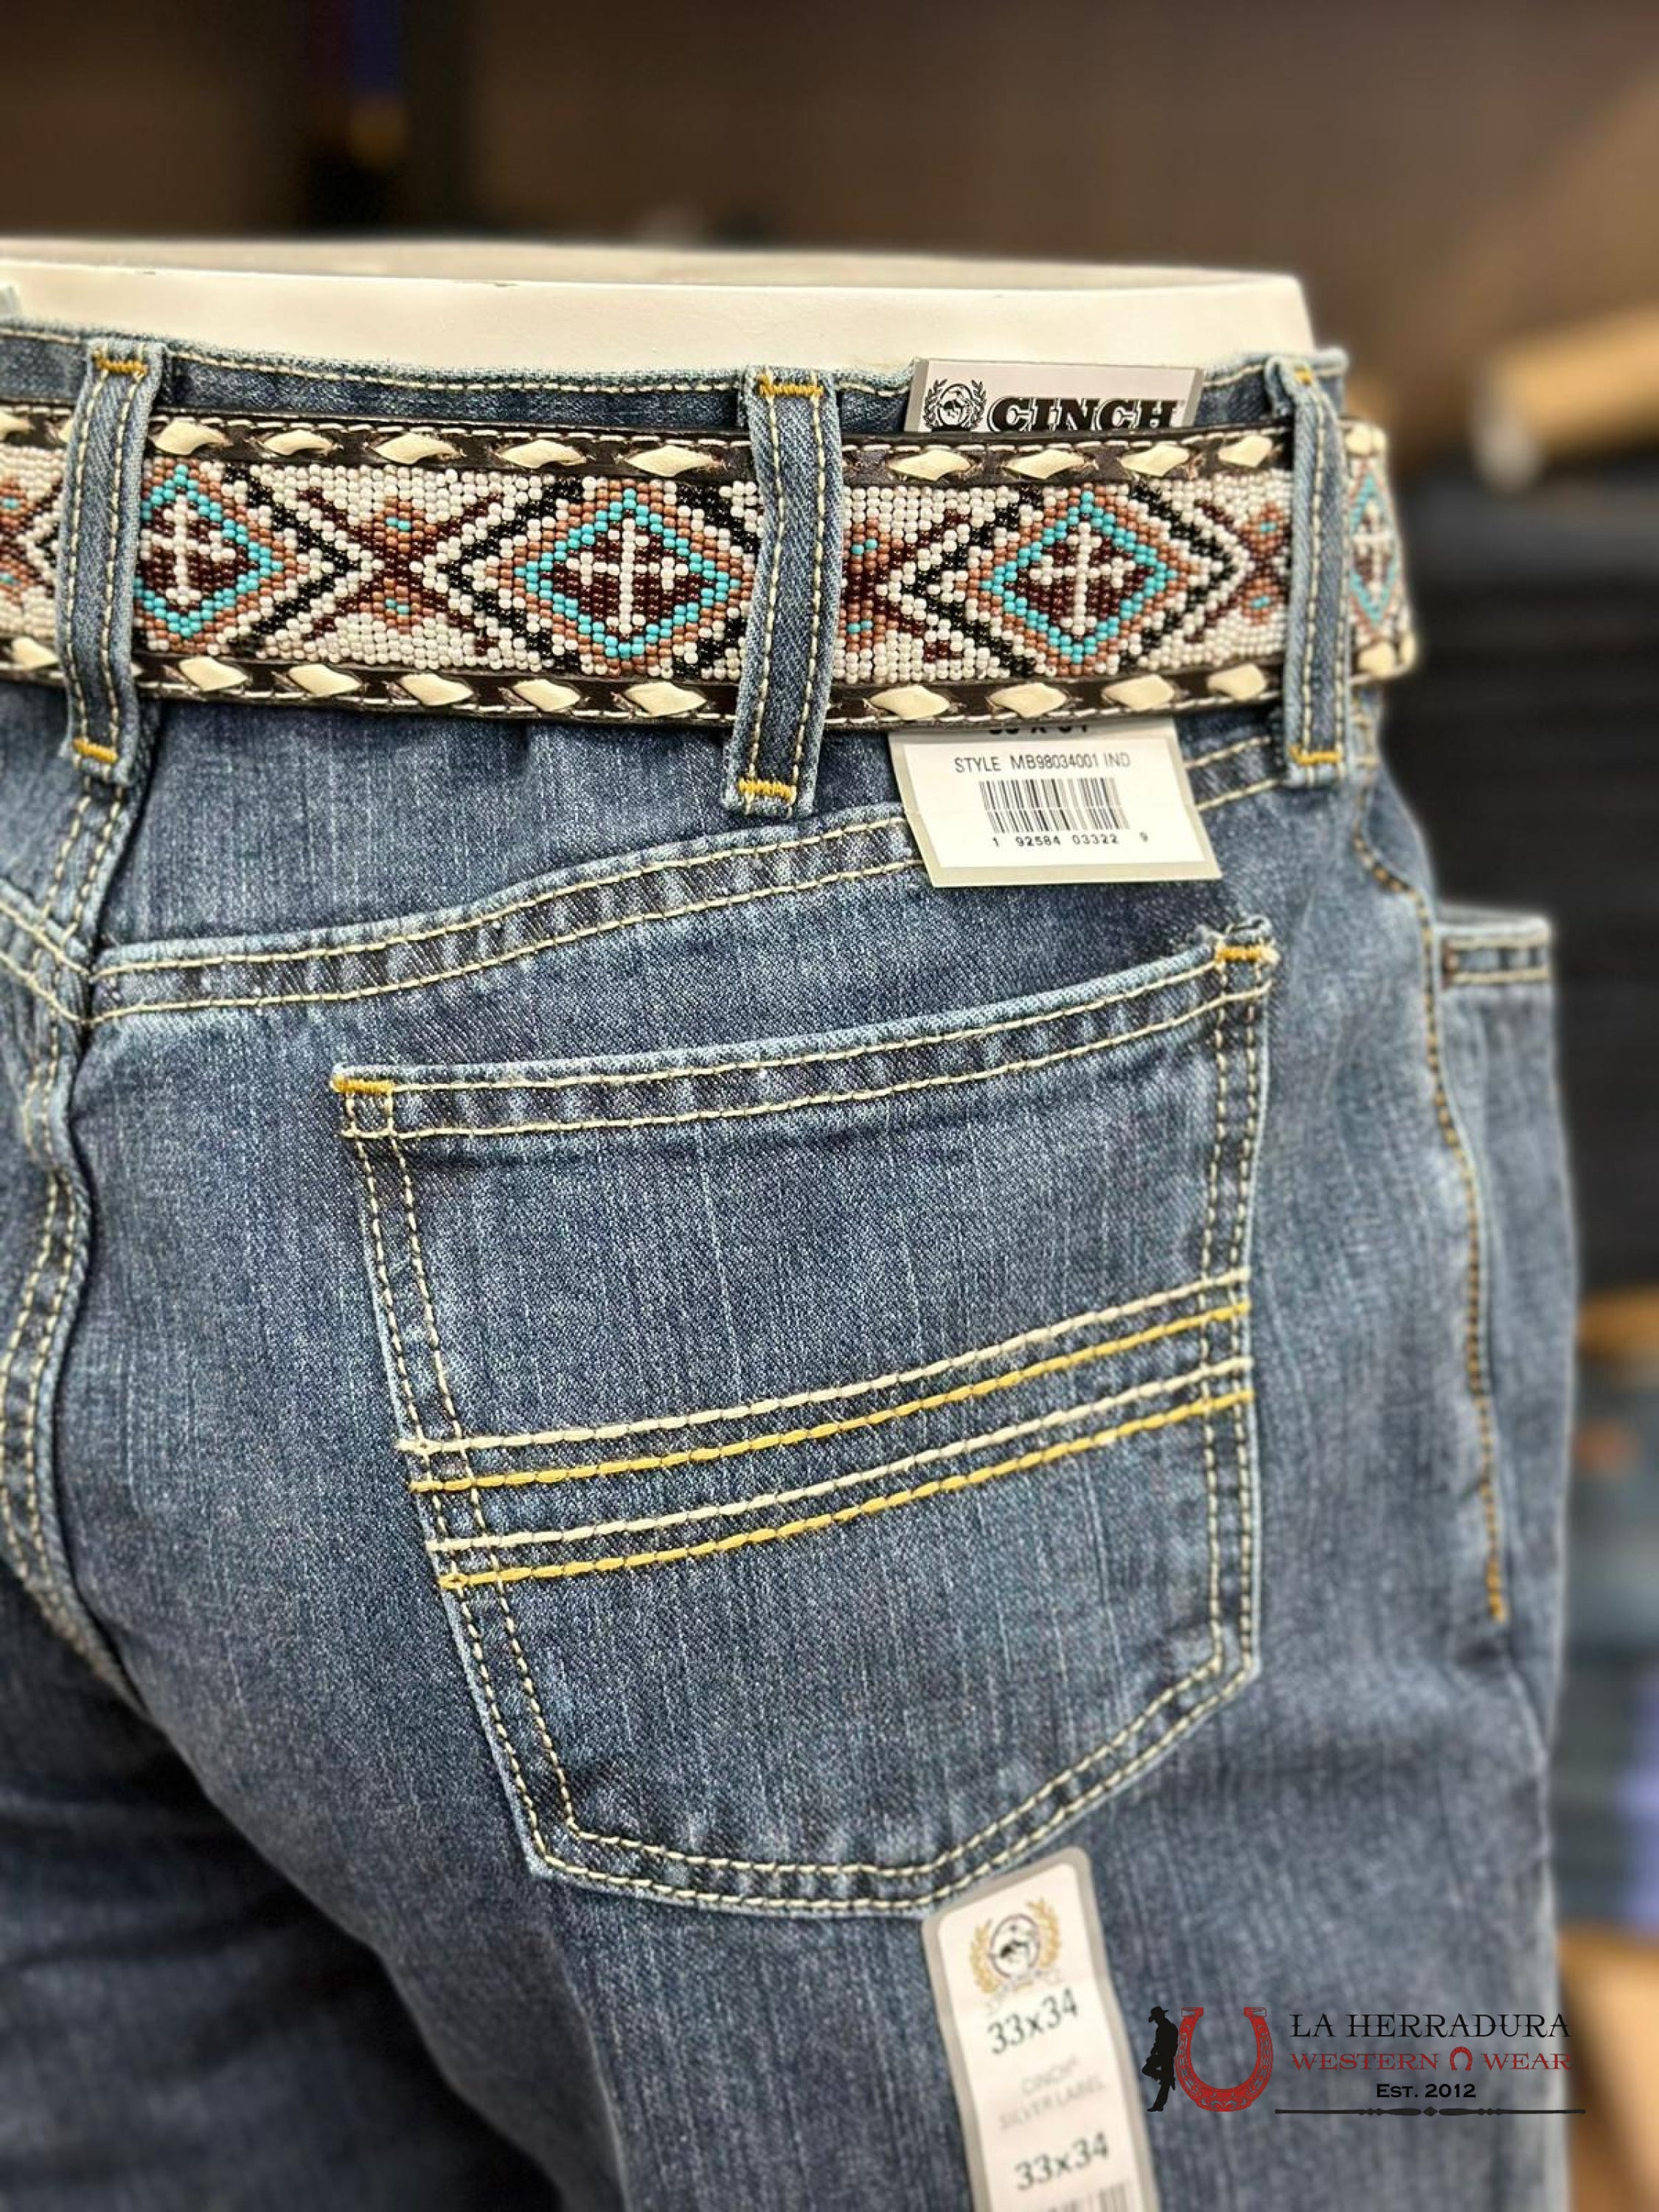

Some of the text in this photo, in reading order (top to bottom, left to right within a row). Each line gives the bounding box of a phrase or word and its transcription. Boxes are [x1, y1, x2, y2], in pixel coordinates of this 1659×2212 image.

[987, 396, 1180, 432] CINCH
[954, 752, 1130, 773] STYLE MB98034001 IND
[992, 832, 1149, 847] 1 92584 03322 9
[987, 1987, 1079, 2054] 33x34
[1013, 2132, 1110, 2192] 33x34
